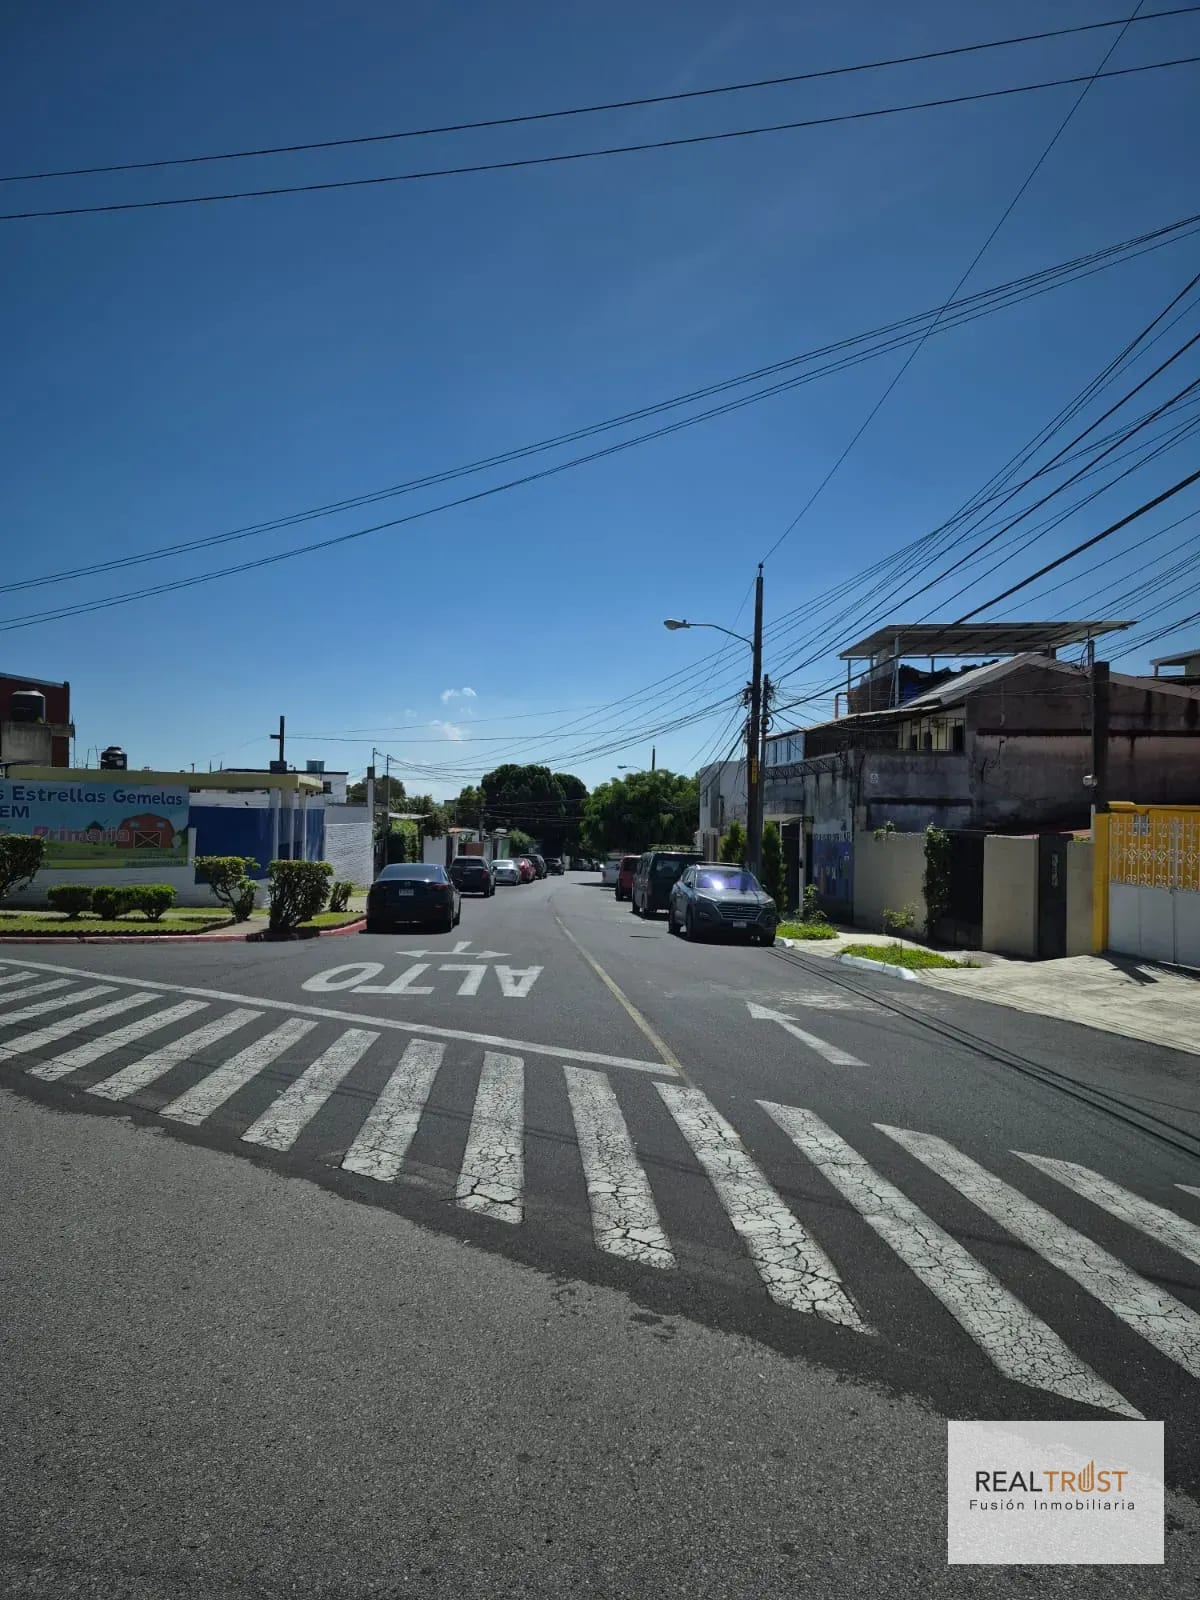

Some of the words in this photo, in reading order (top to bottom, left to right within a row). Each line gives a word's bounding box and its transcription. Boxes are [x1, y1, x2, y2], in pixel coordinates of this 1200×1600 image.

[12, 785, 105, 803] Estrellas
[113, 789, 183, 806] Gemelas
[301, 962, 544, 997] ALTO
